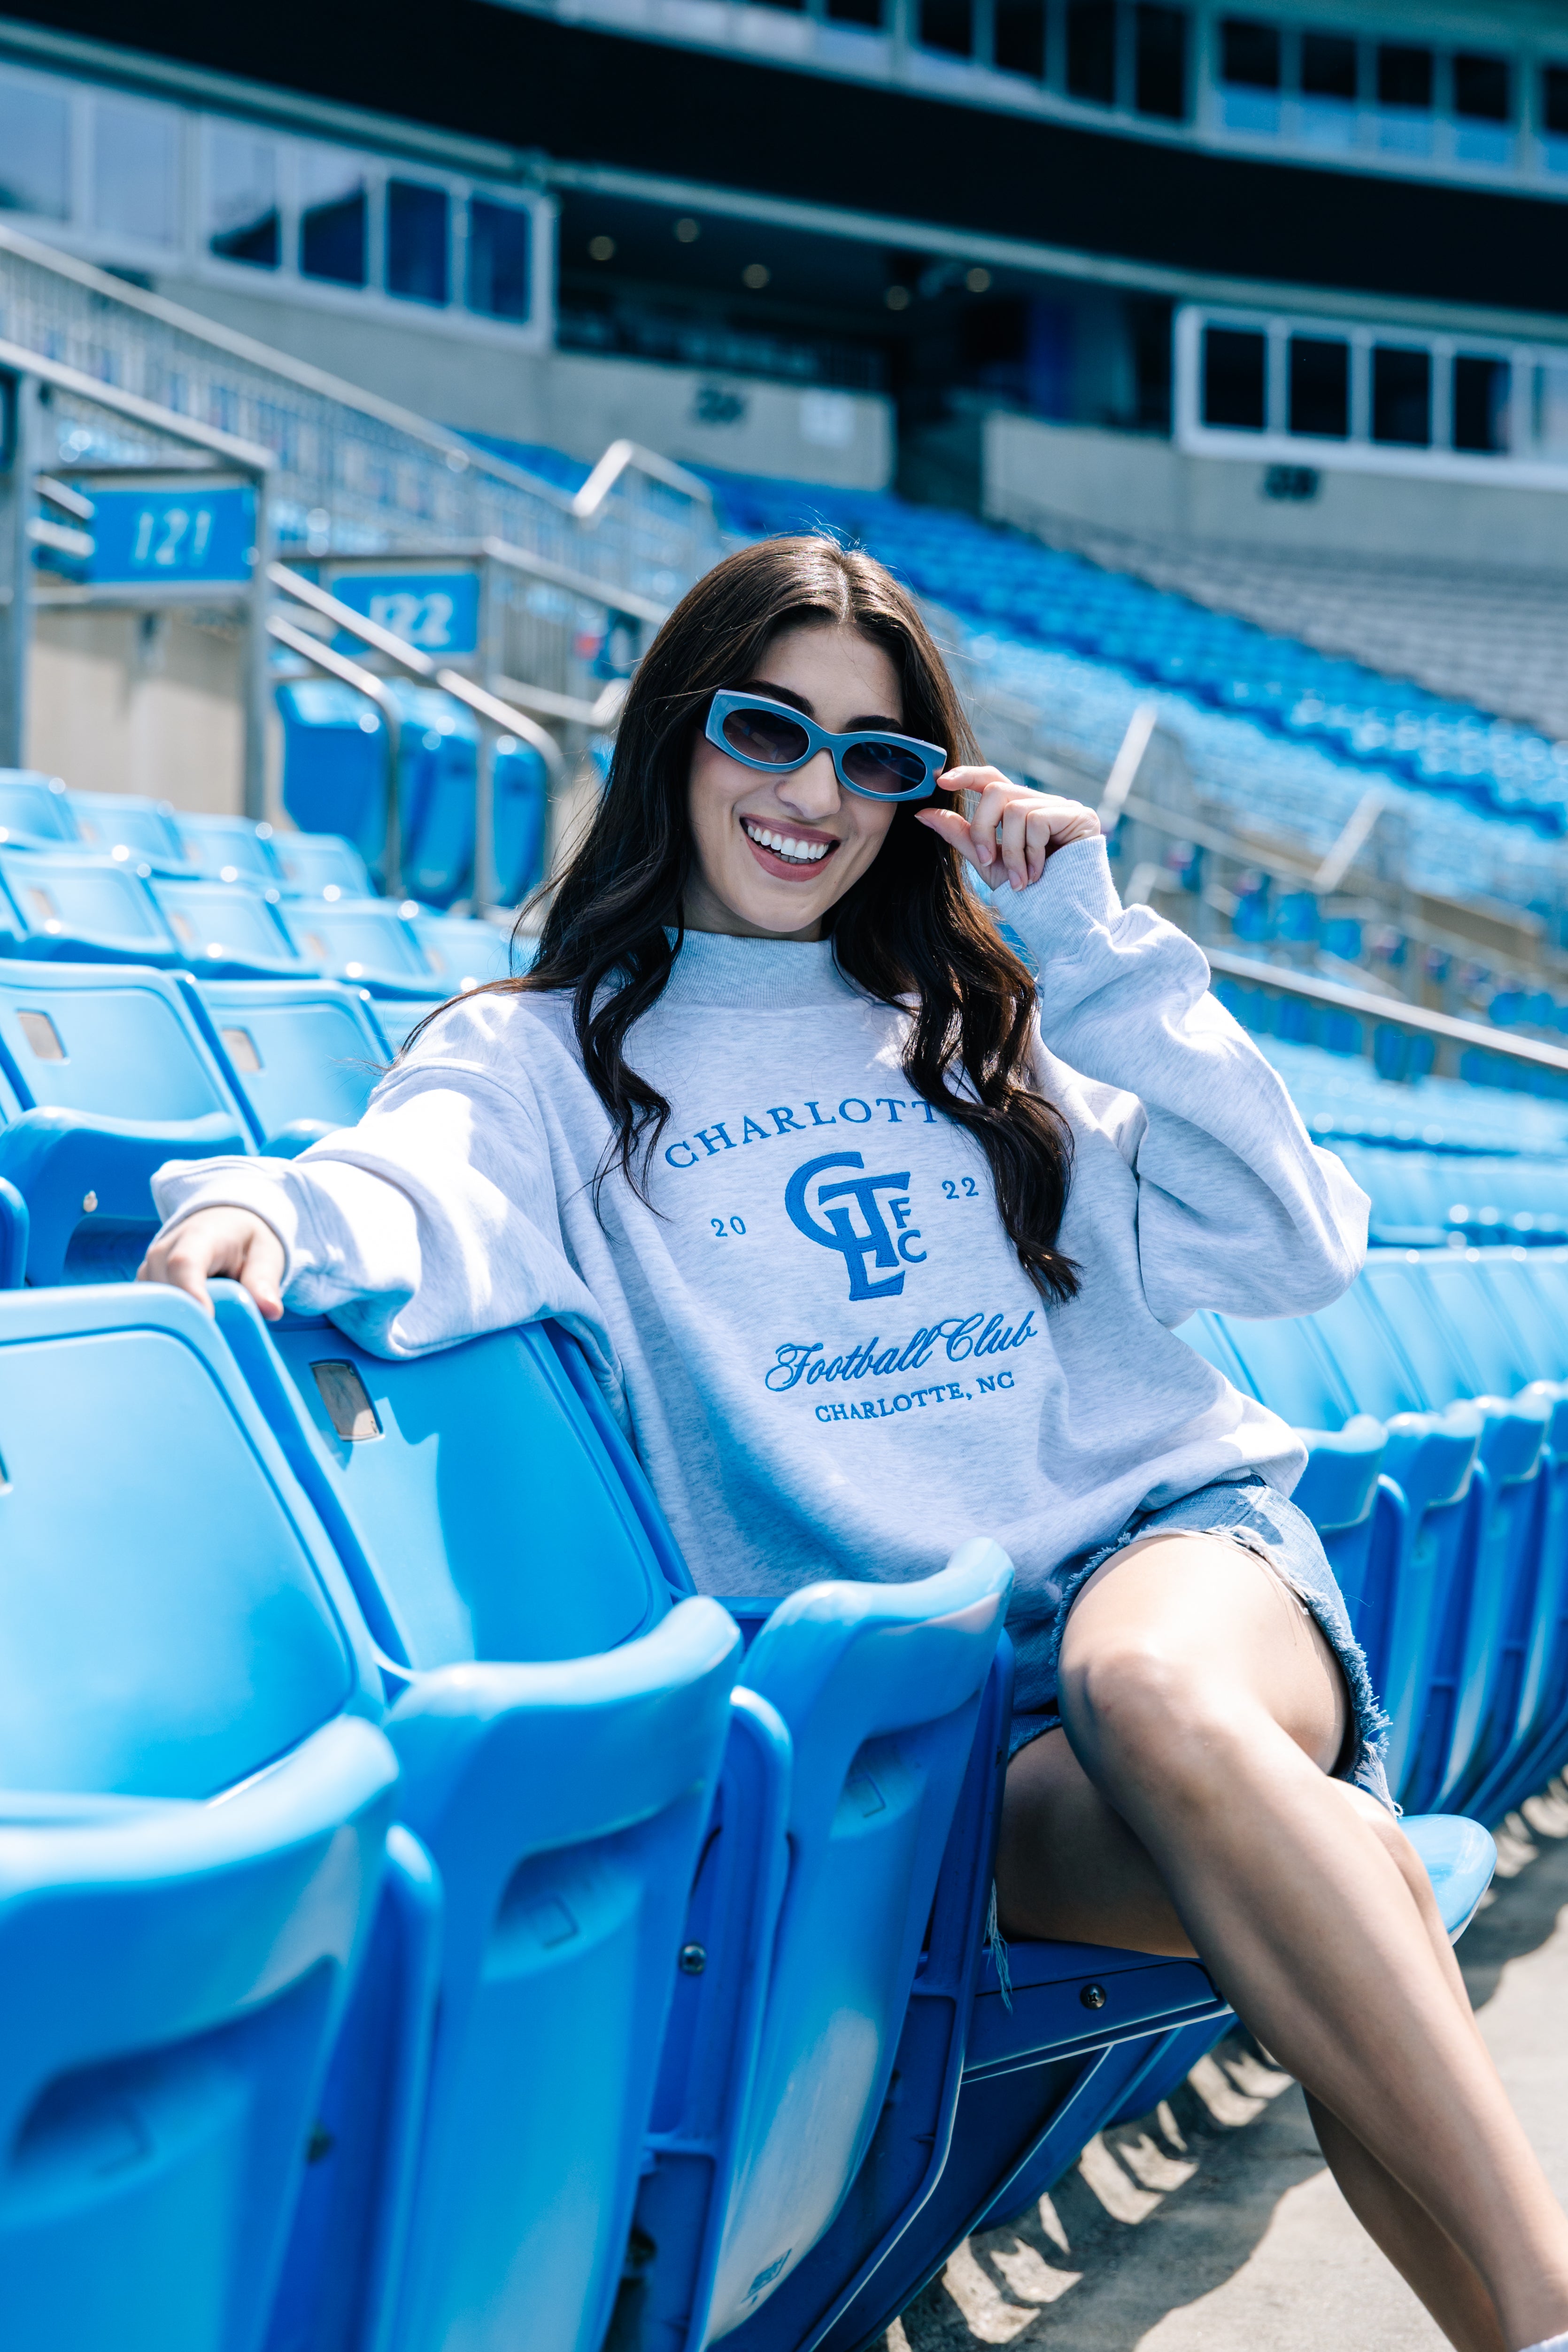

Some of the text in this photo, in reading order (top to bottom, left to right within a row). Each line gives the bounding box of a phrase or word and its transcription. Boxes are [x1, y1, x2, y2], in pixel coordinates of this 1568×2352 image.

[132, 508, 212, 565] 121
[664, 1098, 965, 1169] CHARLOTT
[942, 1177, 979, 1199] 22
[710, 1216, 746, 1237] 20
[765, 1311, 1037, 1392] Football Club
[815, 1371, 1015, 1422] CHARLOTTE, NC
